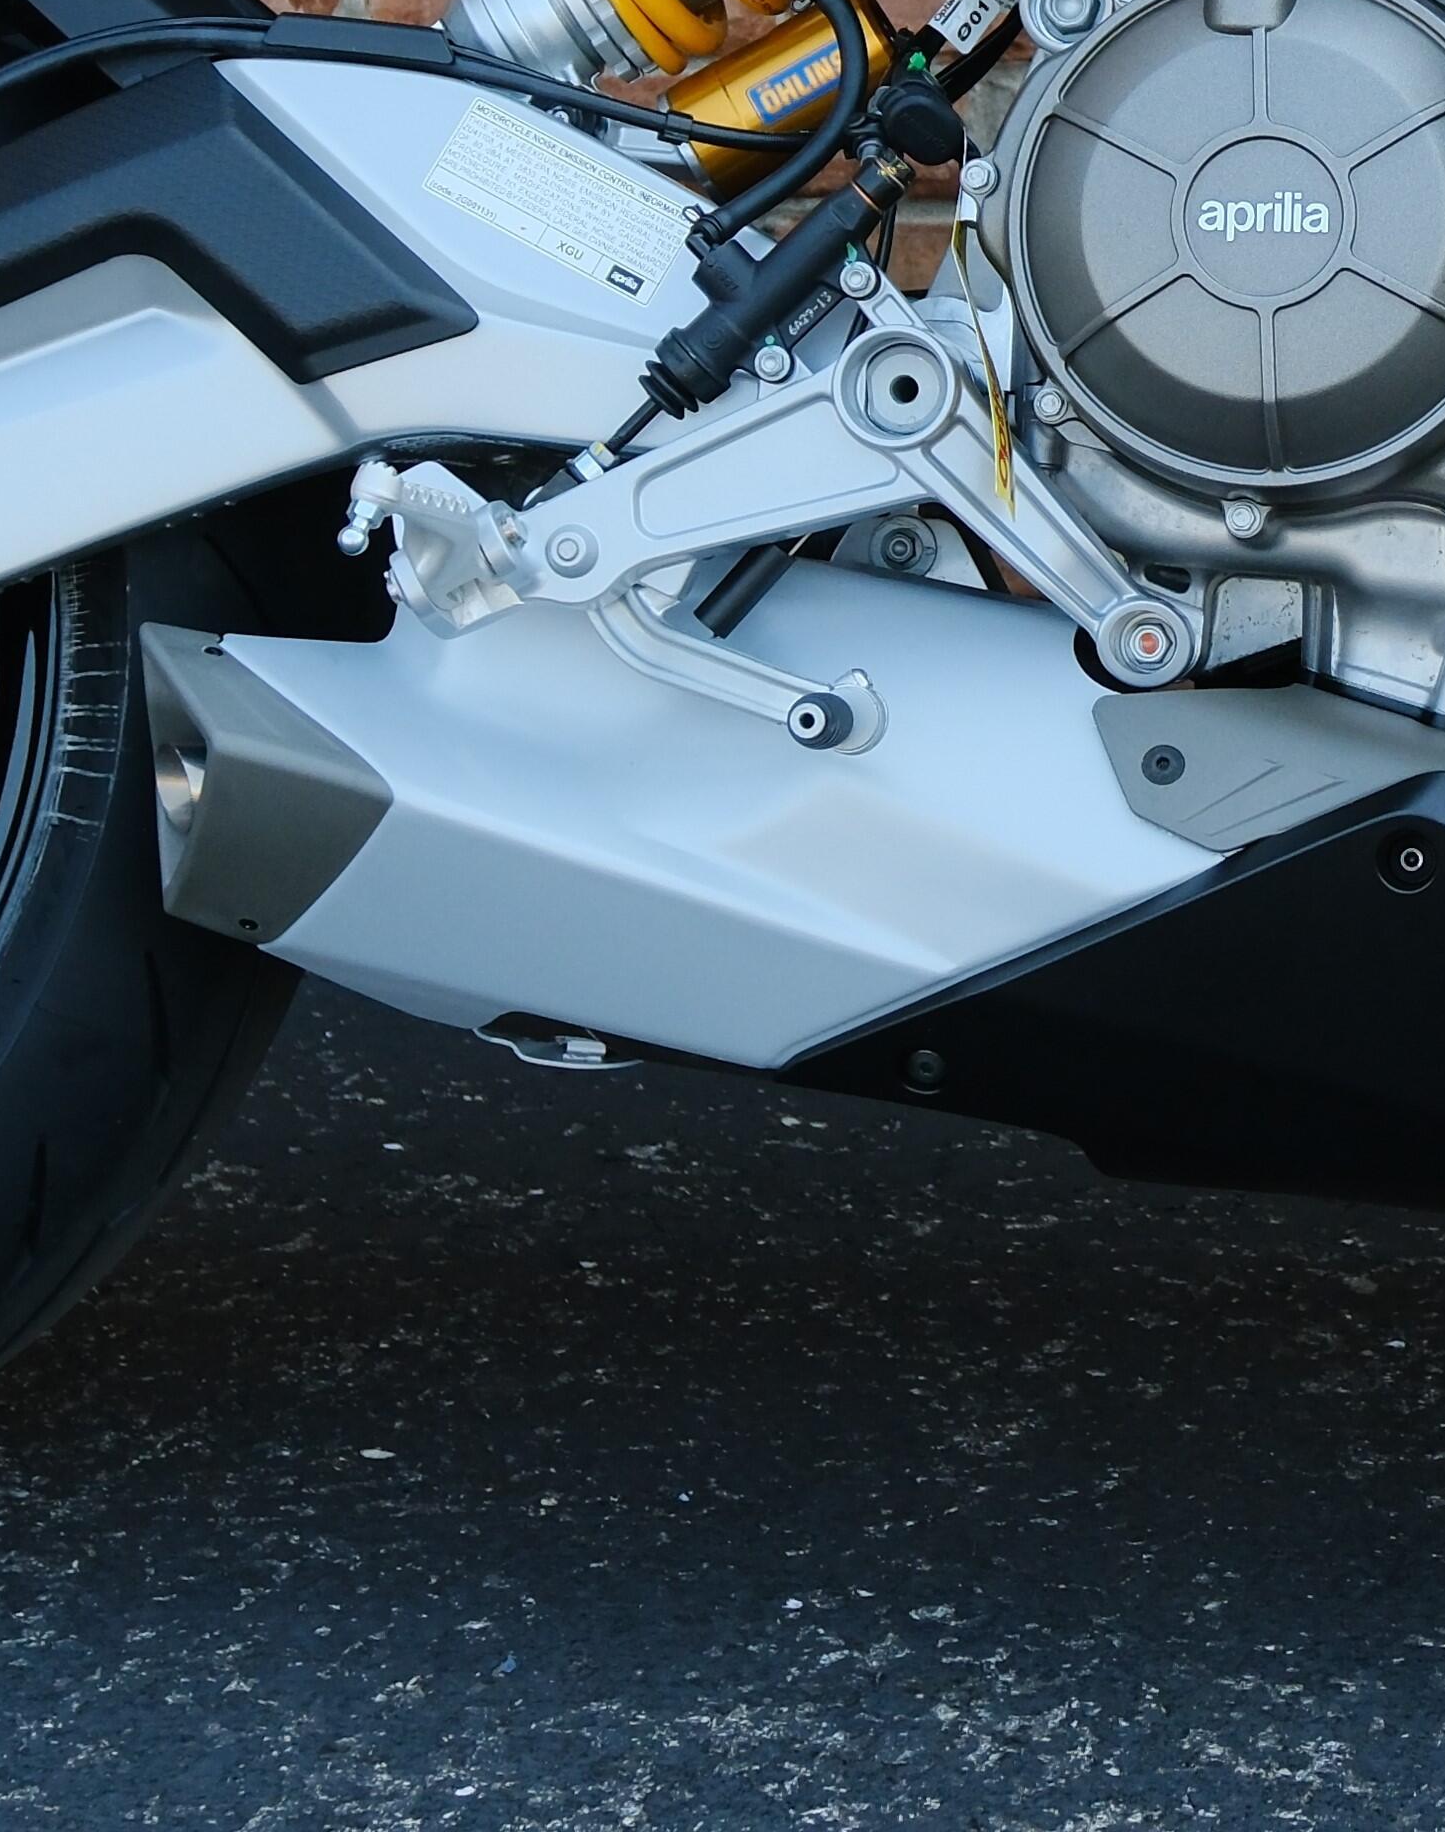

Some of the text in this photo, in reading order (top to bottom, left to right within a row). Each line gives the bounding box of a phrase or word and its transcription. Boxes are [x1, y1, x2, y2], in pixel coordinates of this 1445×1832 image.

[475, 103, 532, 138] MOTORCYCLE
[532, 133, 556, 151] NOISE
[557, 147, 597, 173] EMISSION
[597, 168, 637, 194] CONTROL
[1197, 189, 1330, 242] aprilia
[555, 239, 584, 261] XGU
